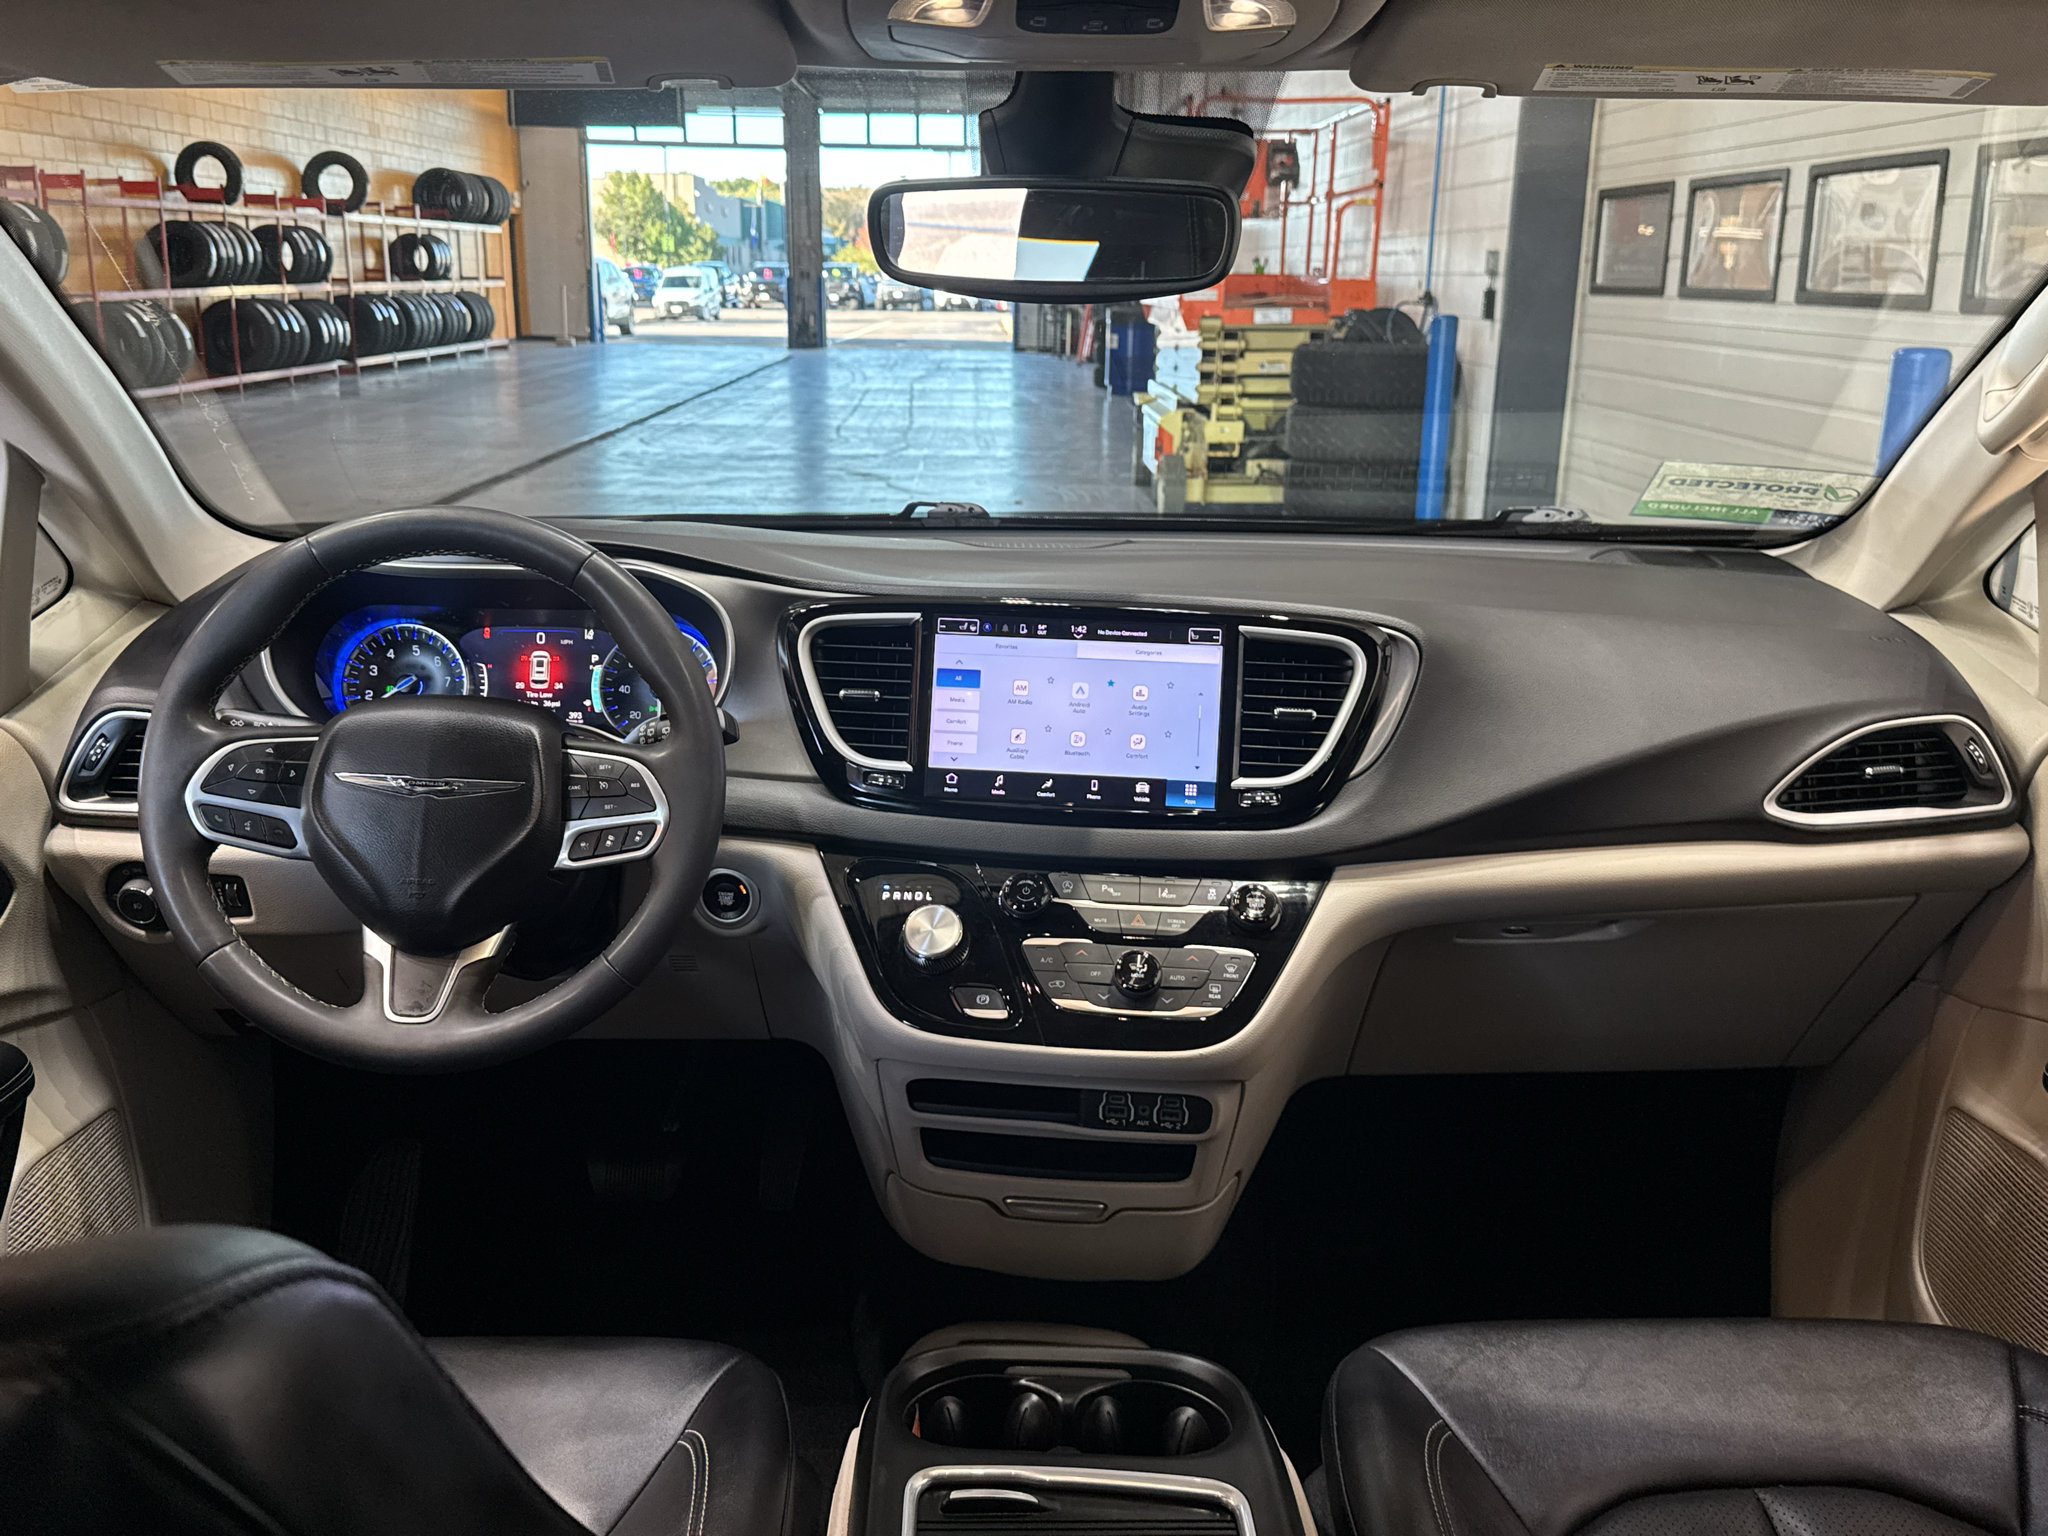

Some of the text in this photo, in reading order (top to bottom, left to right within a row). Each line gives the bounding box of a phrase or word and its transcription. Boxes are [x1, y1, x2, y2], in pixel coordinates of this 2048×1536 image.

[1071, 625, 1087, 633] 1:42
[536, 632, 546, 644] 0
[386, 649, 395, 659] 4
[412, 645, 421, 656] 5
[1135, 649, 1162, 657] Categories
[434, 656, 442, 667] 6
[591, 654, 599, 663] P
[369, 665, 378, 676] 3
[444, 677, 451, 687] 7
[618, 685, 631, 694] 40
[364, 690, 374, 700] 2
[568, 712, 582, 720] 393
[629, 711, 641, 719] 20
